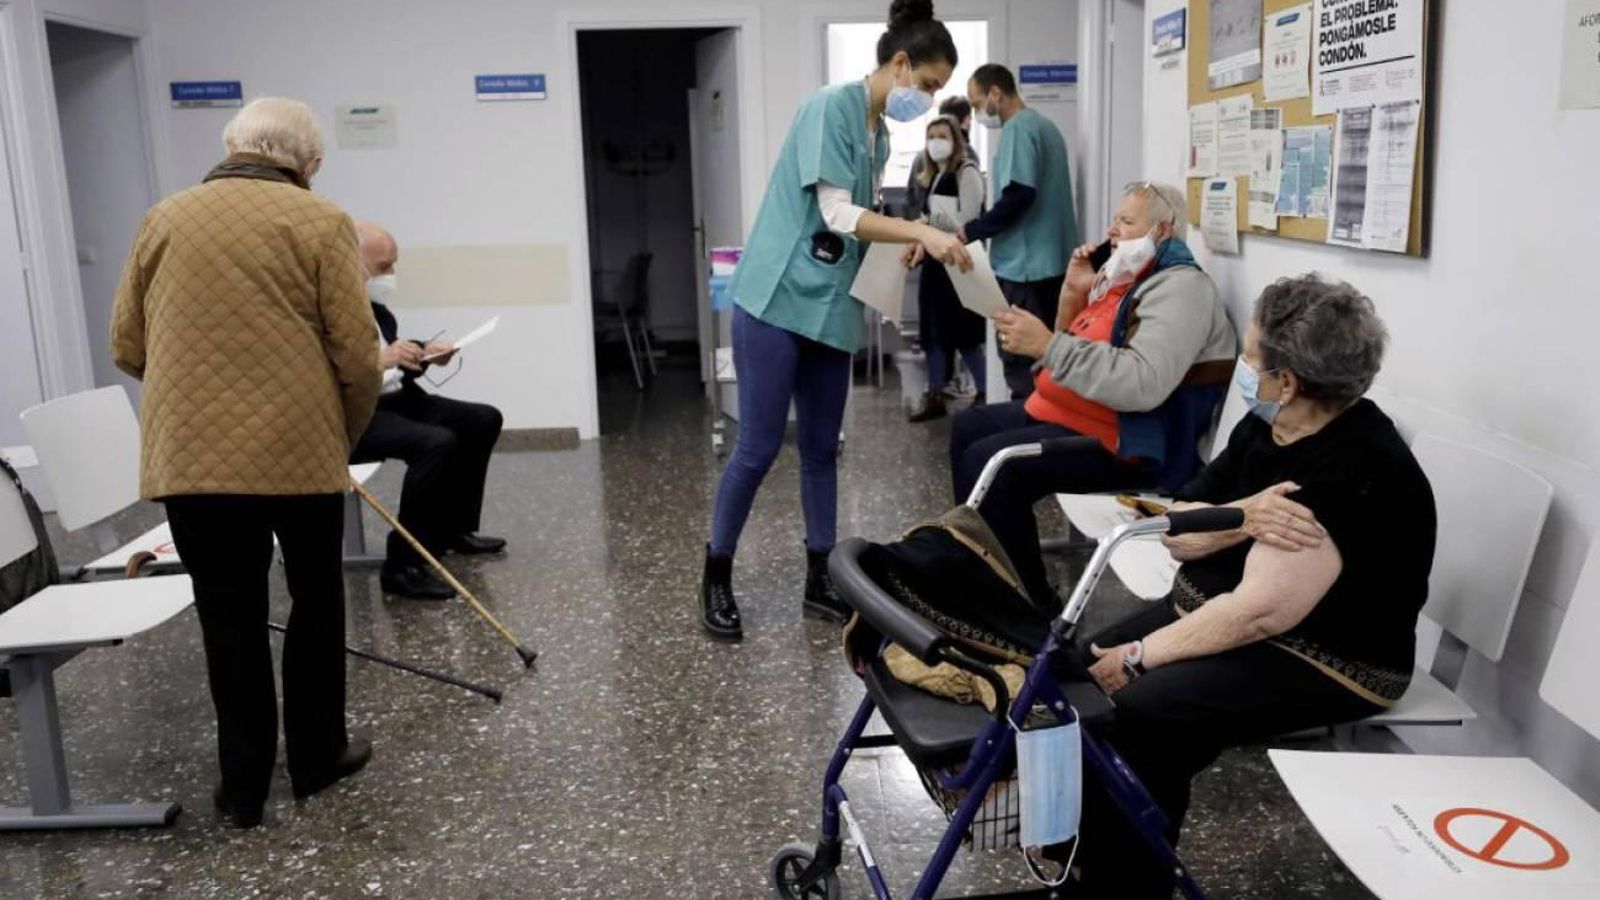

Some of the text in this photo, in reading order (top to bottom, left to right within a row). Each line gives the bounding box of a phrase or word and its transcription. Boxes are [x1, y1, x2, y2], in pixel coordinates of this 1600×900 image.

[1321, 12, 1332, 28] EL
[1335, 0, 1398, 24] PROBLEMA.
[1319, 13, 1396, 46] PONGÁMOSLE
[1319, 40, 1367, 66] CONDÓN.
